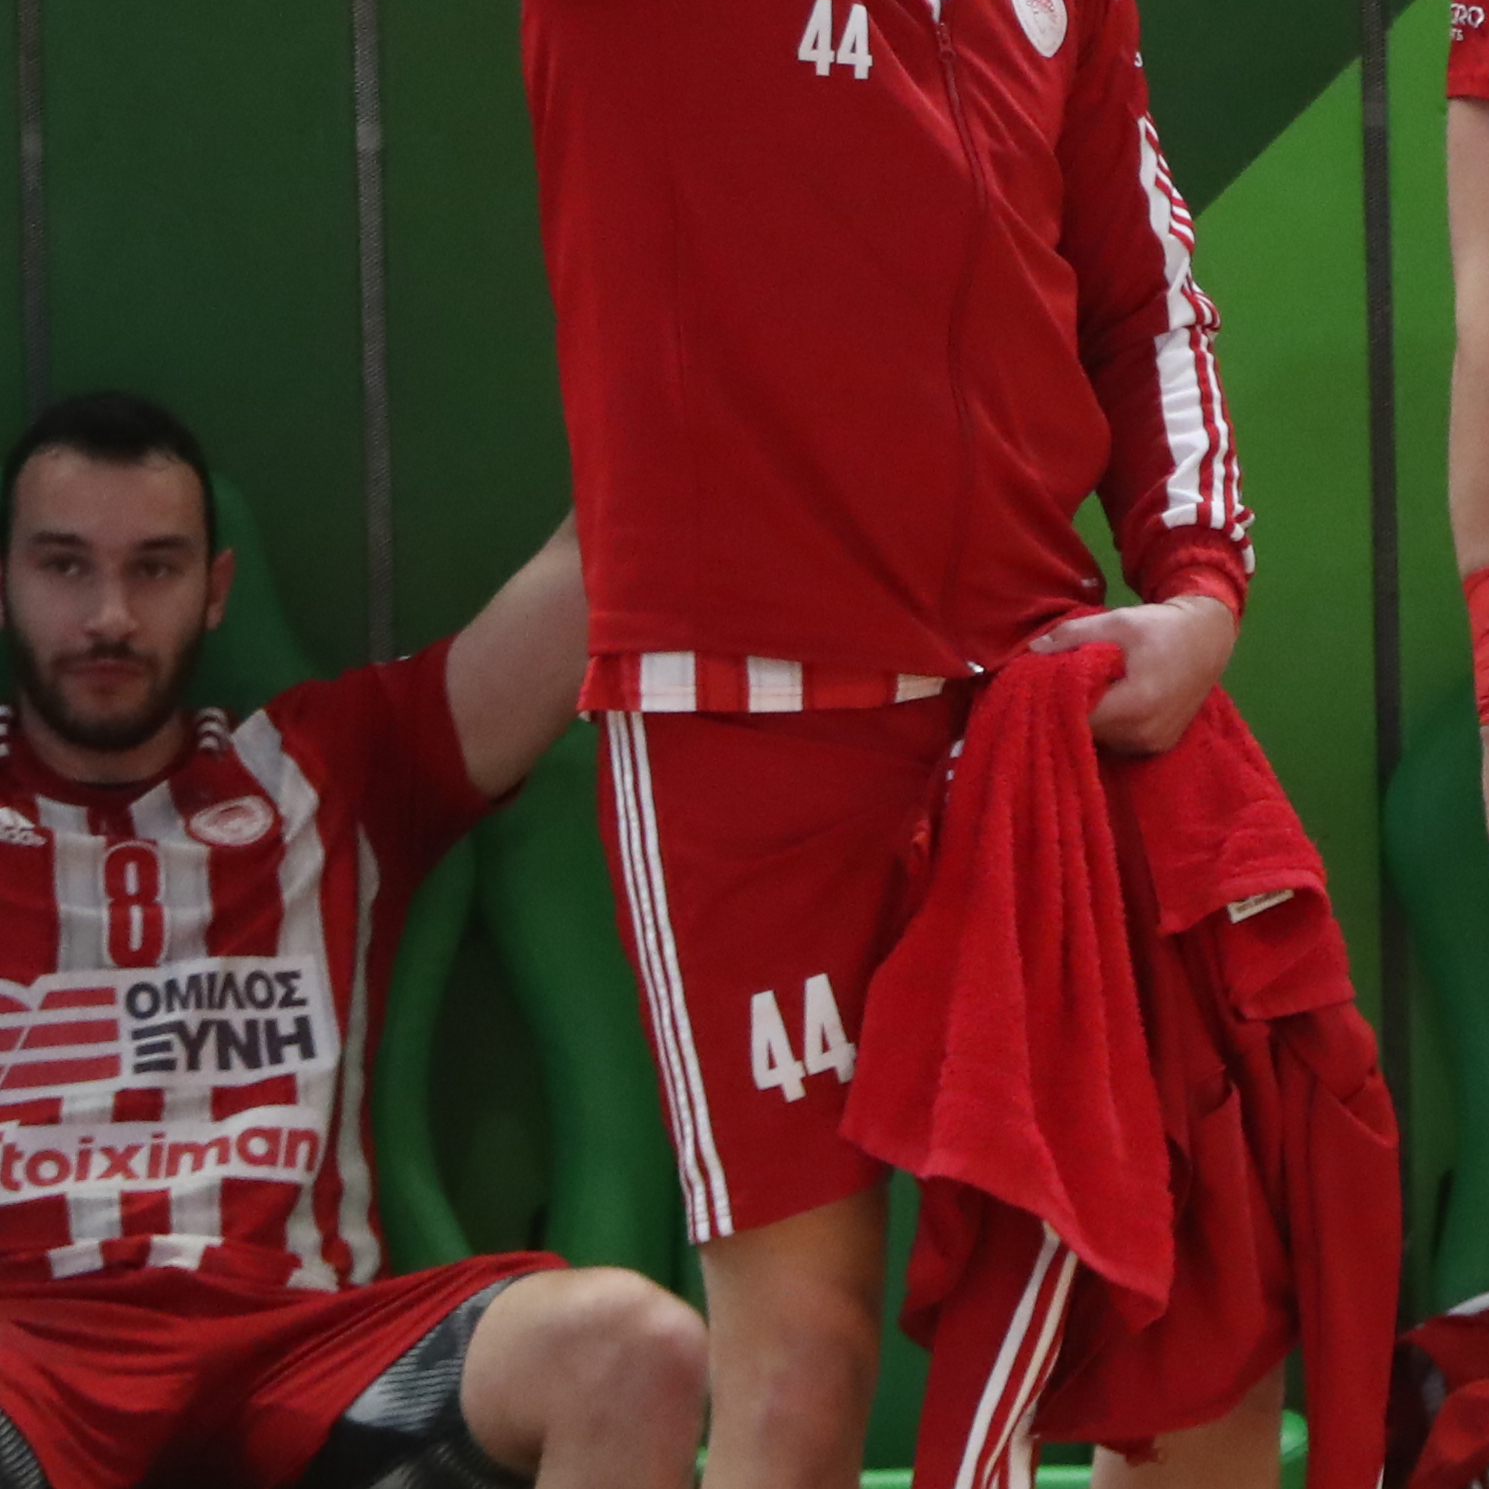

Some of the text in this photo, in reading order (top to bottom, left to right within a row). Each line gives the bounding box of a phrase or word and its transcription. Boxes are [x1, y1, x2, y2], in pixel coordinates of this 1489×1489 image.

[102, 839, 169, 969] 8
[125, 970, 307, 1019] ΟΜΙΛΟΣ
[131, 1015, 316, 1074] ΞΥΝΗ
[749, 972, 858, 1103] 44
[0, 1127, 320, 1191] toiximan
